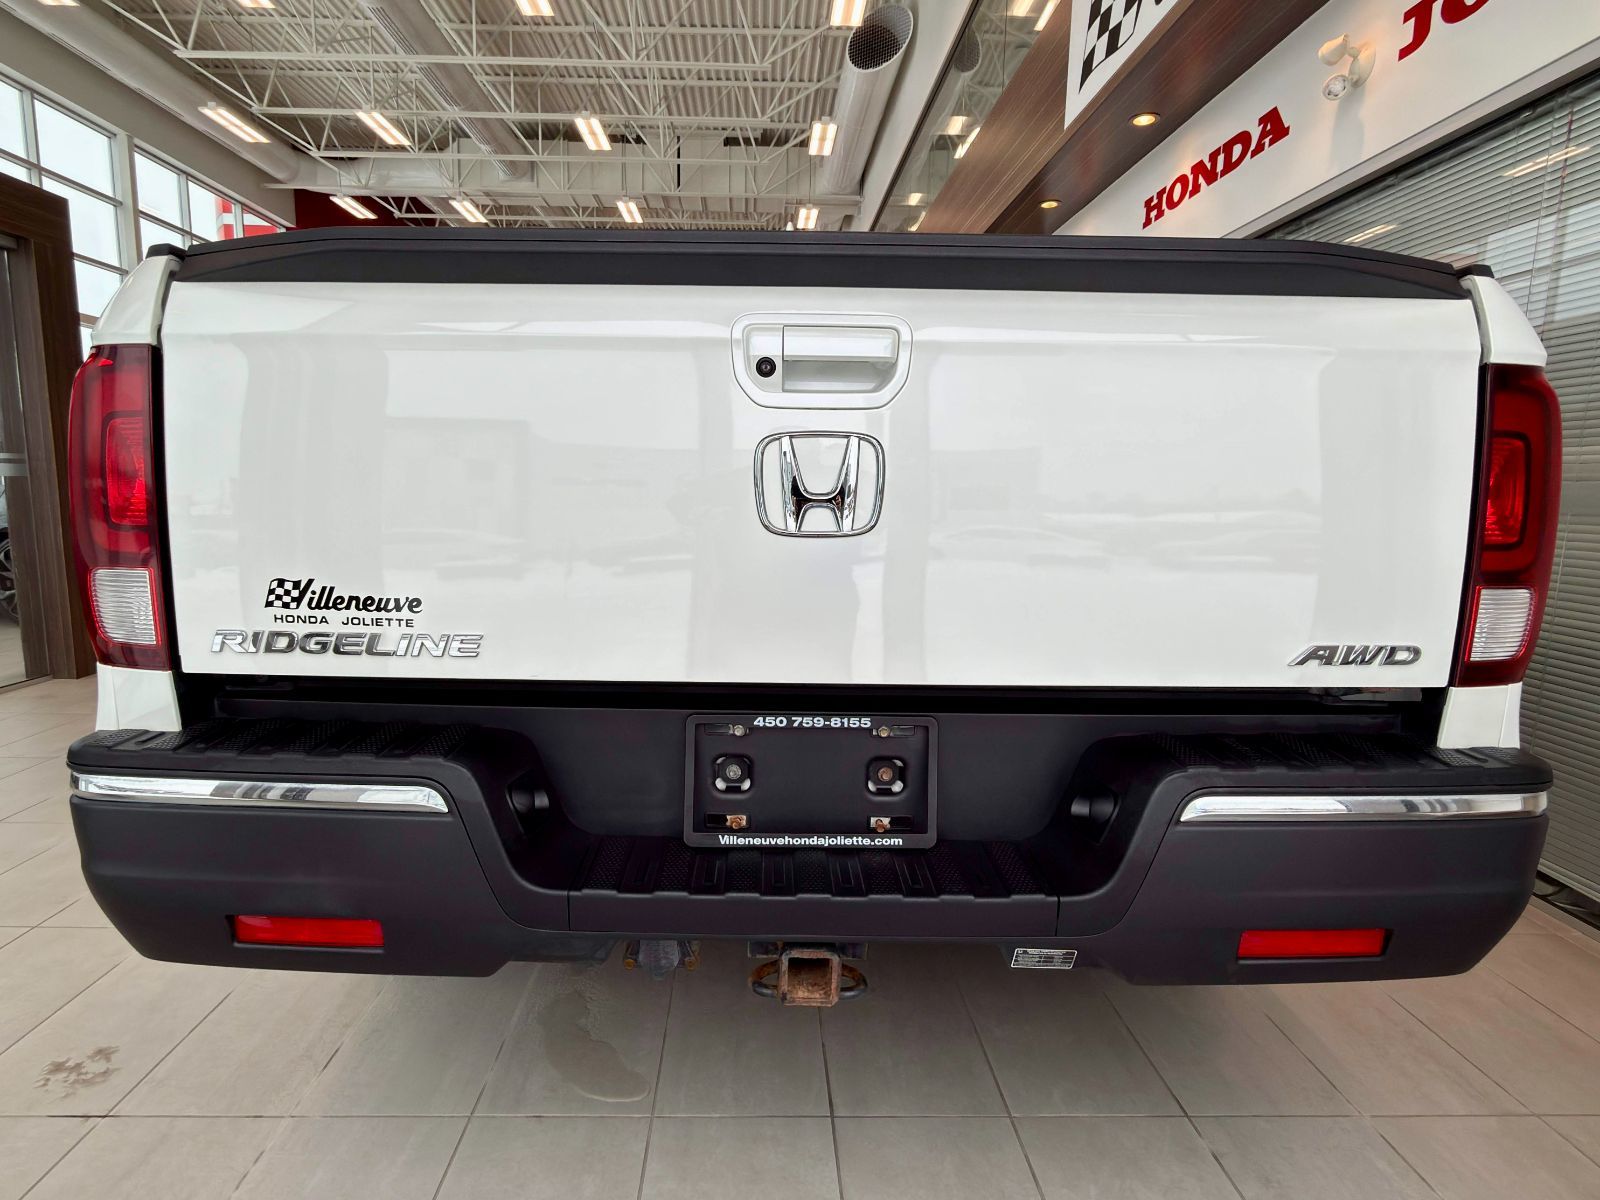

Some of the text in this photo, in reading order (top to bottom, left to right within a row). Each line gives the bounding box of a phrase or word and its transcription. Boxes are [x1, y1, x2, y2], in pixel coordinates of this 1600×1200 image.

[1142, 106, 1290, 229] HONDA
[265, 578, 423, 614] Villeneuve
[273, 614, 415, 628] HONDA JOLIETTE
[211, 629, 484, 658] RIDGELINE
[1287, 644, 1422, 667] AWD
[753, 716, 872, 729] 450 759-8155
[718, 834, 903, 848] Villeneuvehondajoliette.com
